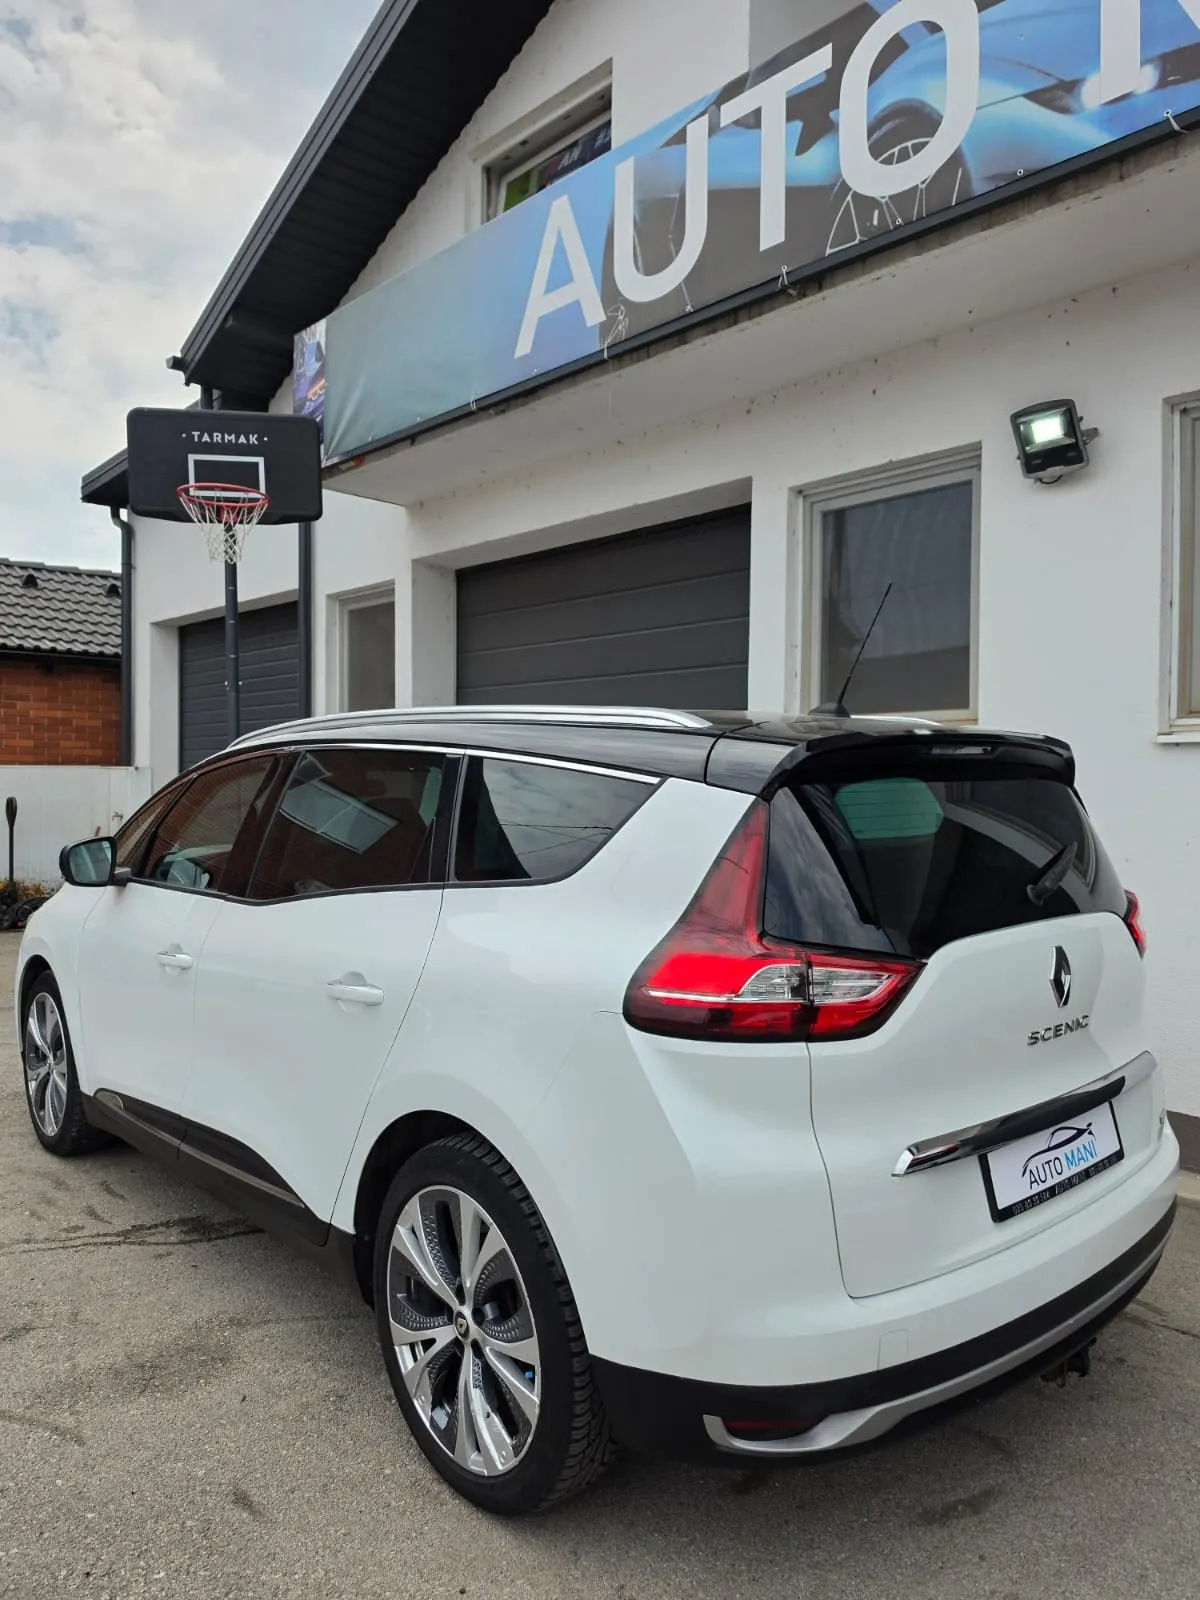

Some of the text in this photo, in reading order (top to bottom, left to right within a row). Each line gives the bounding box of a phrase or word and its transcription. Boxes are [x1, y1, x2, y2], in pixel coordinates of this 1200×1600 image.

[514, 0, 979, 358] AUTO
[191, 431, 259, 445] TARMAK
[1027, 1015, 1089, 1046] SCENIC
[1029, 1156, 1063, 1190] AUTO
[1064, 1139, 1097, 1170] MANI
